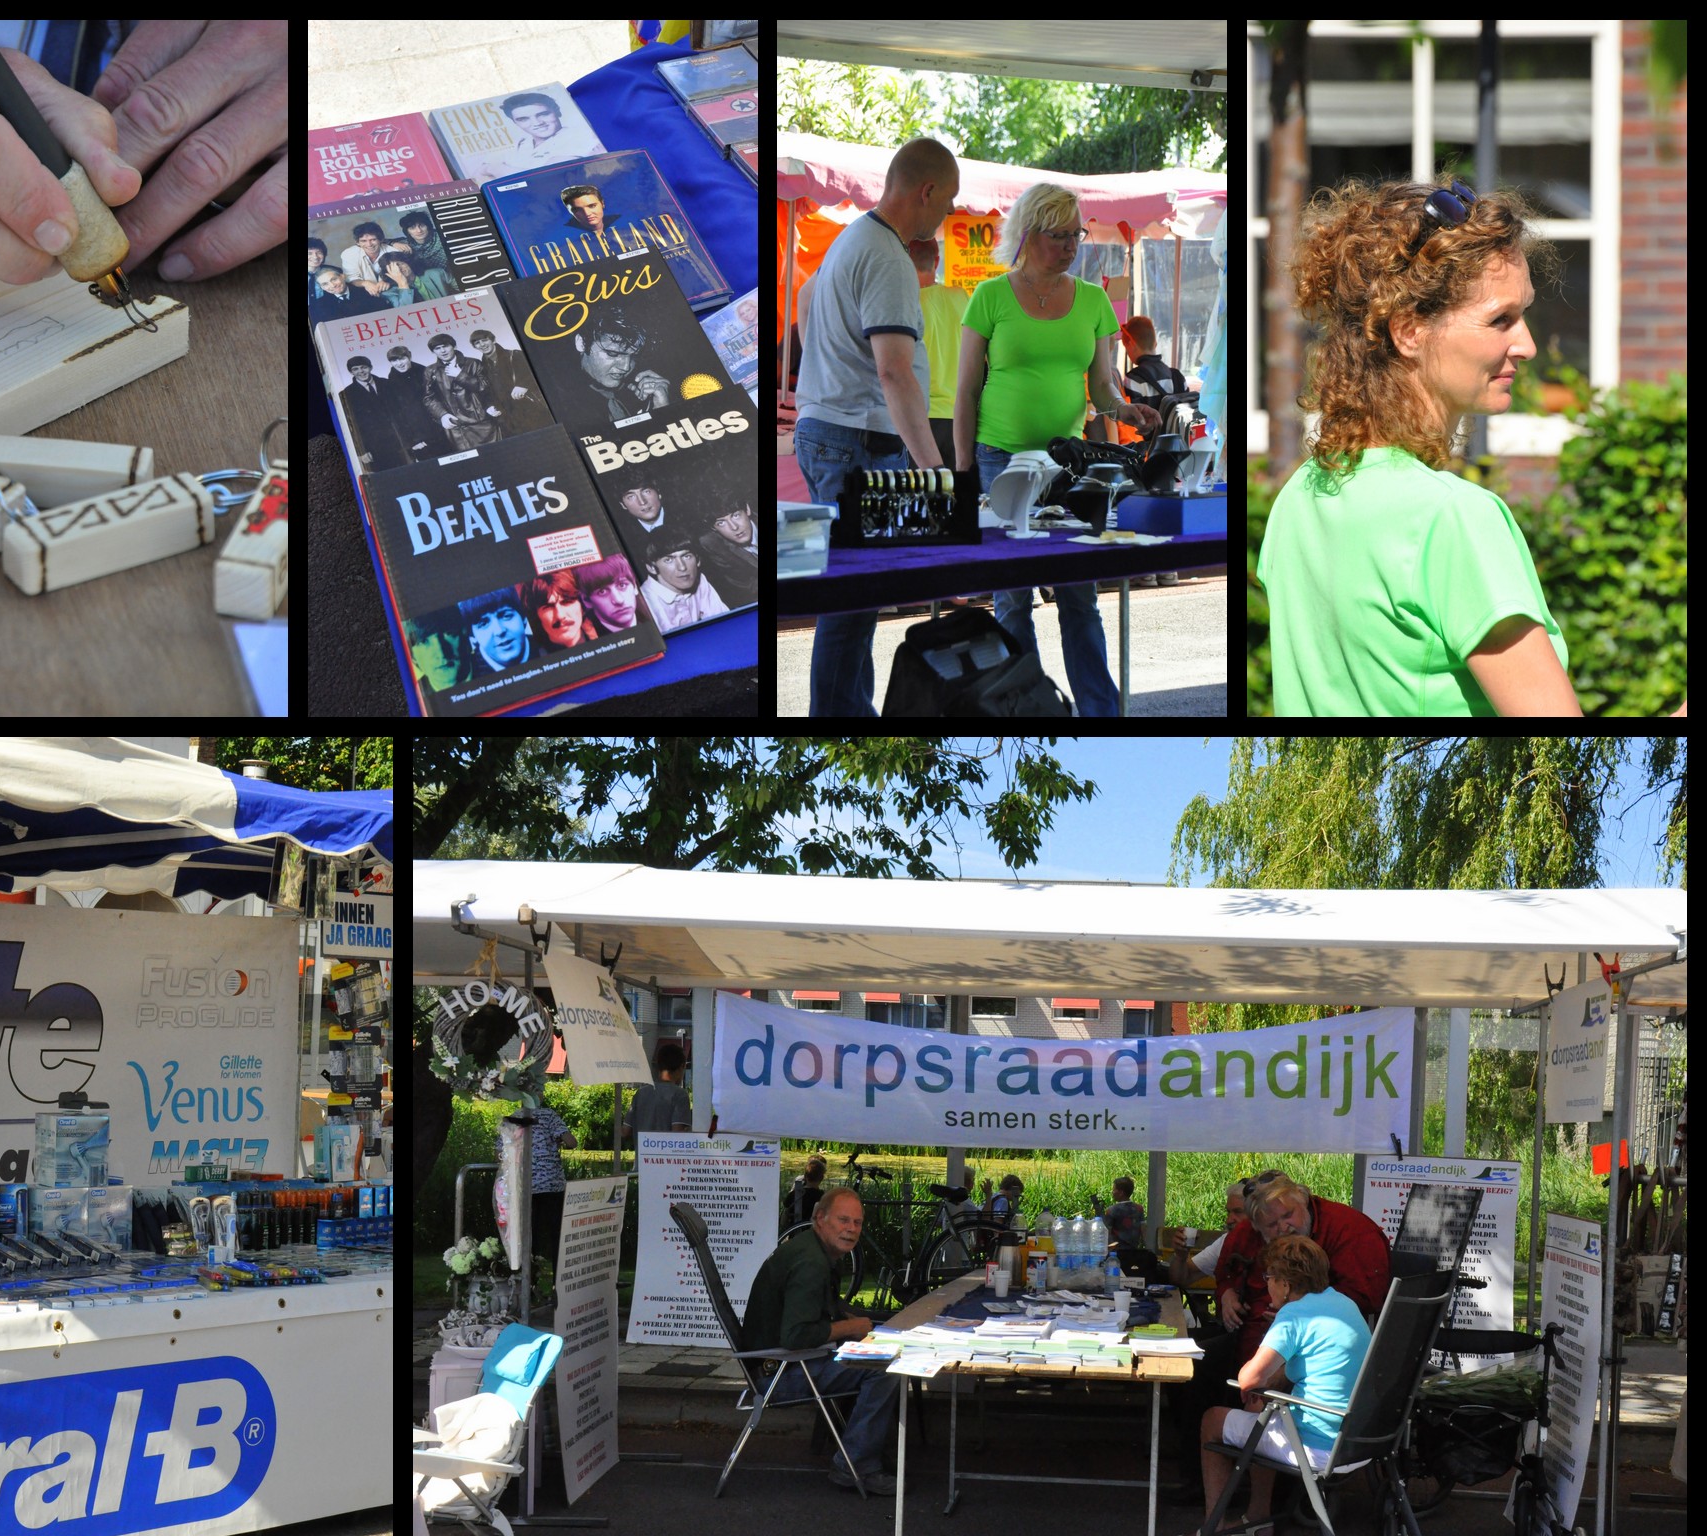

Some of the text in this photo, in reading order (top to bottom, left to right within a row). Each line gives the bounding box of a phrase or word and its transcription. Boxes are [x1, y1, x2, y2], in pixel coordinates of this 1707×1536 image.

[314, 143, 359, 160] THE
[454, 126, 514, 154] PRESLEY
[320, 146, 414, 173] ROLLING
[323, 161, 407, 185] STONES
[455, 185, 474, 194] THE
[432, 196, 502, 266] ROLLING
[529, 214, 685, 275] GRACELAND
[523, 265, 662, 341] Elvis
[342, 297, 484, 344] THE BEATLES
[348, 317, 487, 352] UNSEEN ARCHIVES
[580, 434, 602, 445] The
[585, 410, 749, 475] Beatles
[458, 476, 495, 498] THE
[396, 476, 568, 556] BEATLES
[451, 694, 466, 703] You
[467, 686, 486, 698] don't
[487, 679, 504, 691] need
[513, 668, 543, 684] imagine.
[543, 661, 559, 673] Now
[561, 653, 583, 666] re-live
[583, 650, 595, 659] the
[595, 643, 617, 656] whole
[617, 637, 636, 649] story
[326, 925, 392, 948] JA GRAAG
[141, 954, 271, 998] Fusion
[439, 981, 545, 1038] HOME
[220, 1055, 262, 1070] Gillette
[734, 1024, 1400, 1117] dorpsraadandijk
[220, 1070, 261, 1079] for Women
[126, 1060, 264, 1132] Venus
[58, 1118, 77, 1126] Oral-B
[944, 1108, 1147, 1131] samen sterk...
[148, 1138, 269, 1174] MACH3
[643, 1138, 731, 1151] dorpsraadandijk
[211, 1167, 225, 1175] DERBY
[1371, 1161, 1467, 1177] dorpsraadandijk
[45, 1191, 61, 1199] Oral-B
[91, 1189, 106, 1197] Oral-B
[669, 1193, 756, 1201] HONDENUITLAATPLAATSEN
[1486, 1187, 1513, 1195] BEZIG?
